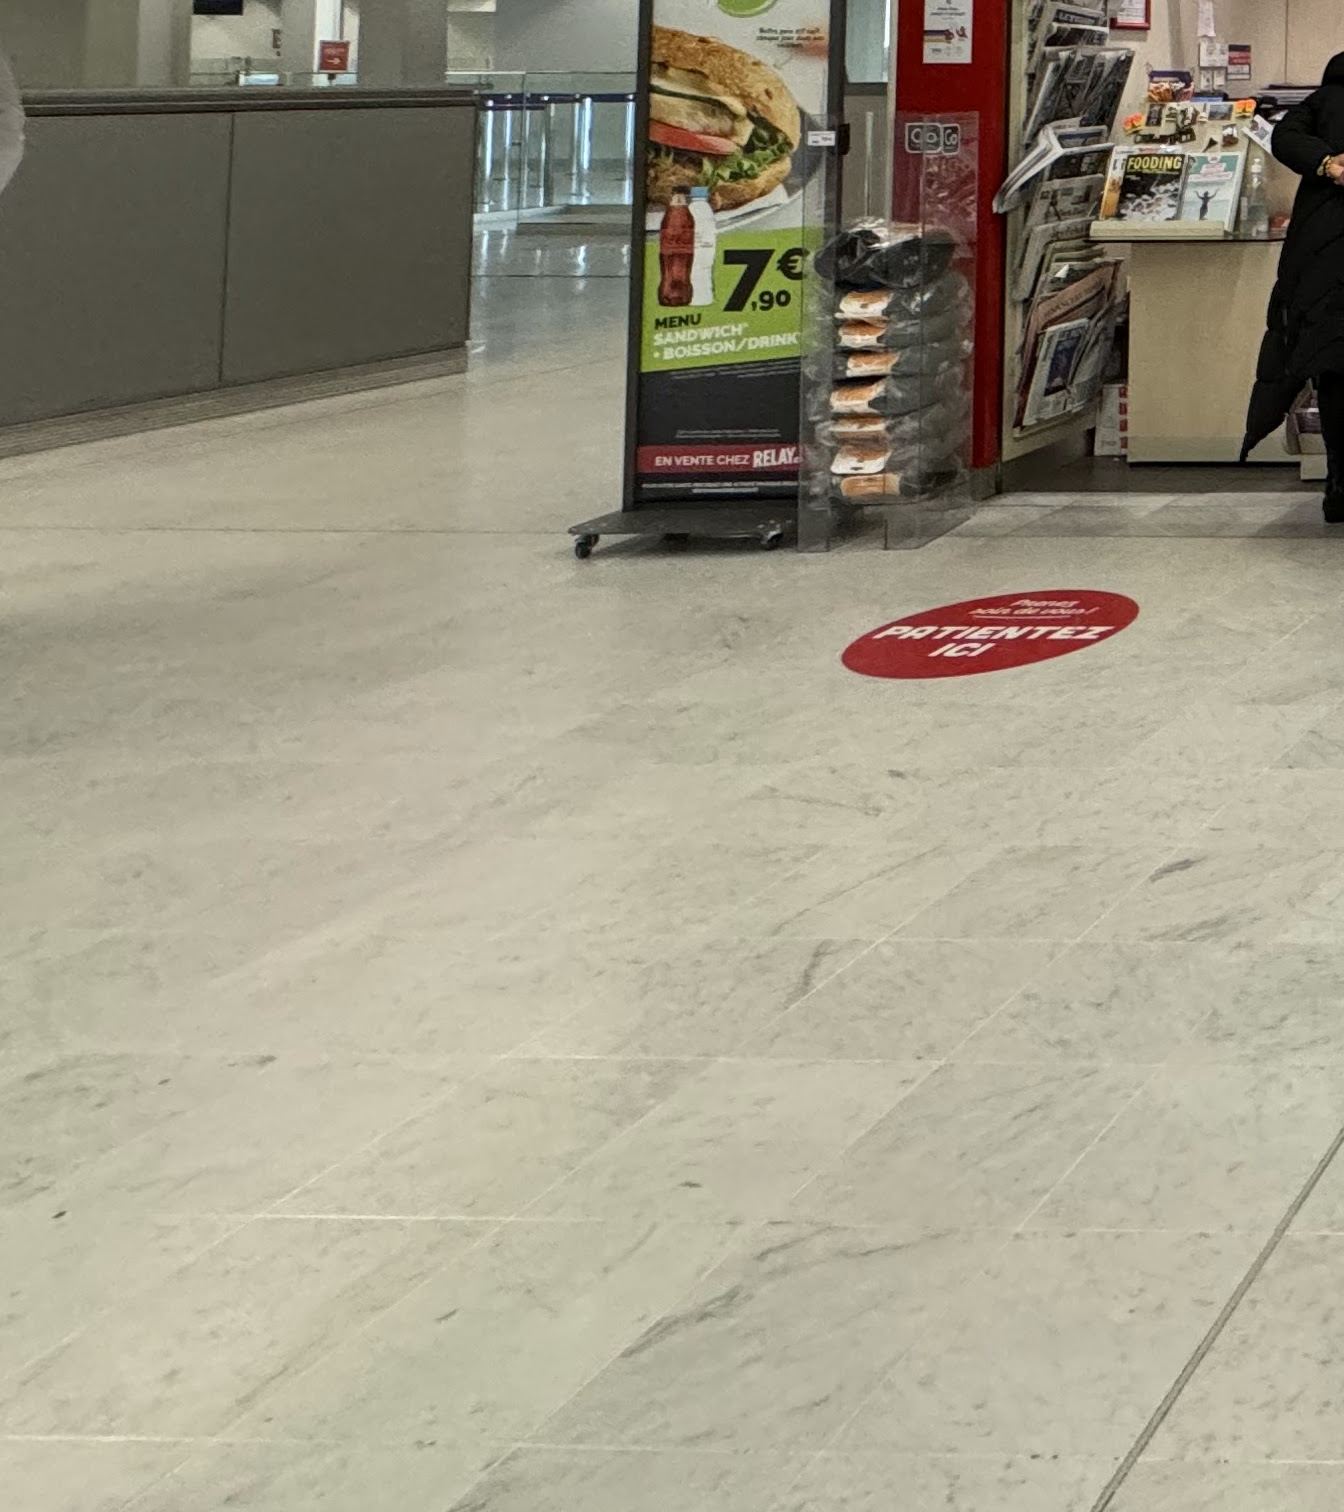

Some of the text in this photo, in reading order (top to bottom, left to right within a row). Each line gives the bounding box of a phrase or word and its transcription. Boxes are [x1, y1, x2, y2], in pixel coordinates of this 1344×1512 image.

[1127, 155, 1182, 169] FOODING
[654, 313, 702, 330] MENU
[655, 455, 673, 467] EN
[675, 455, 714, 467] VENTE
[716, 454, 750, 466] CHEZ
[872, 626, 1116, 640] PATIENTEZ
[928, 643, 996, 657] ICI
